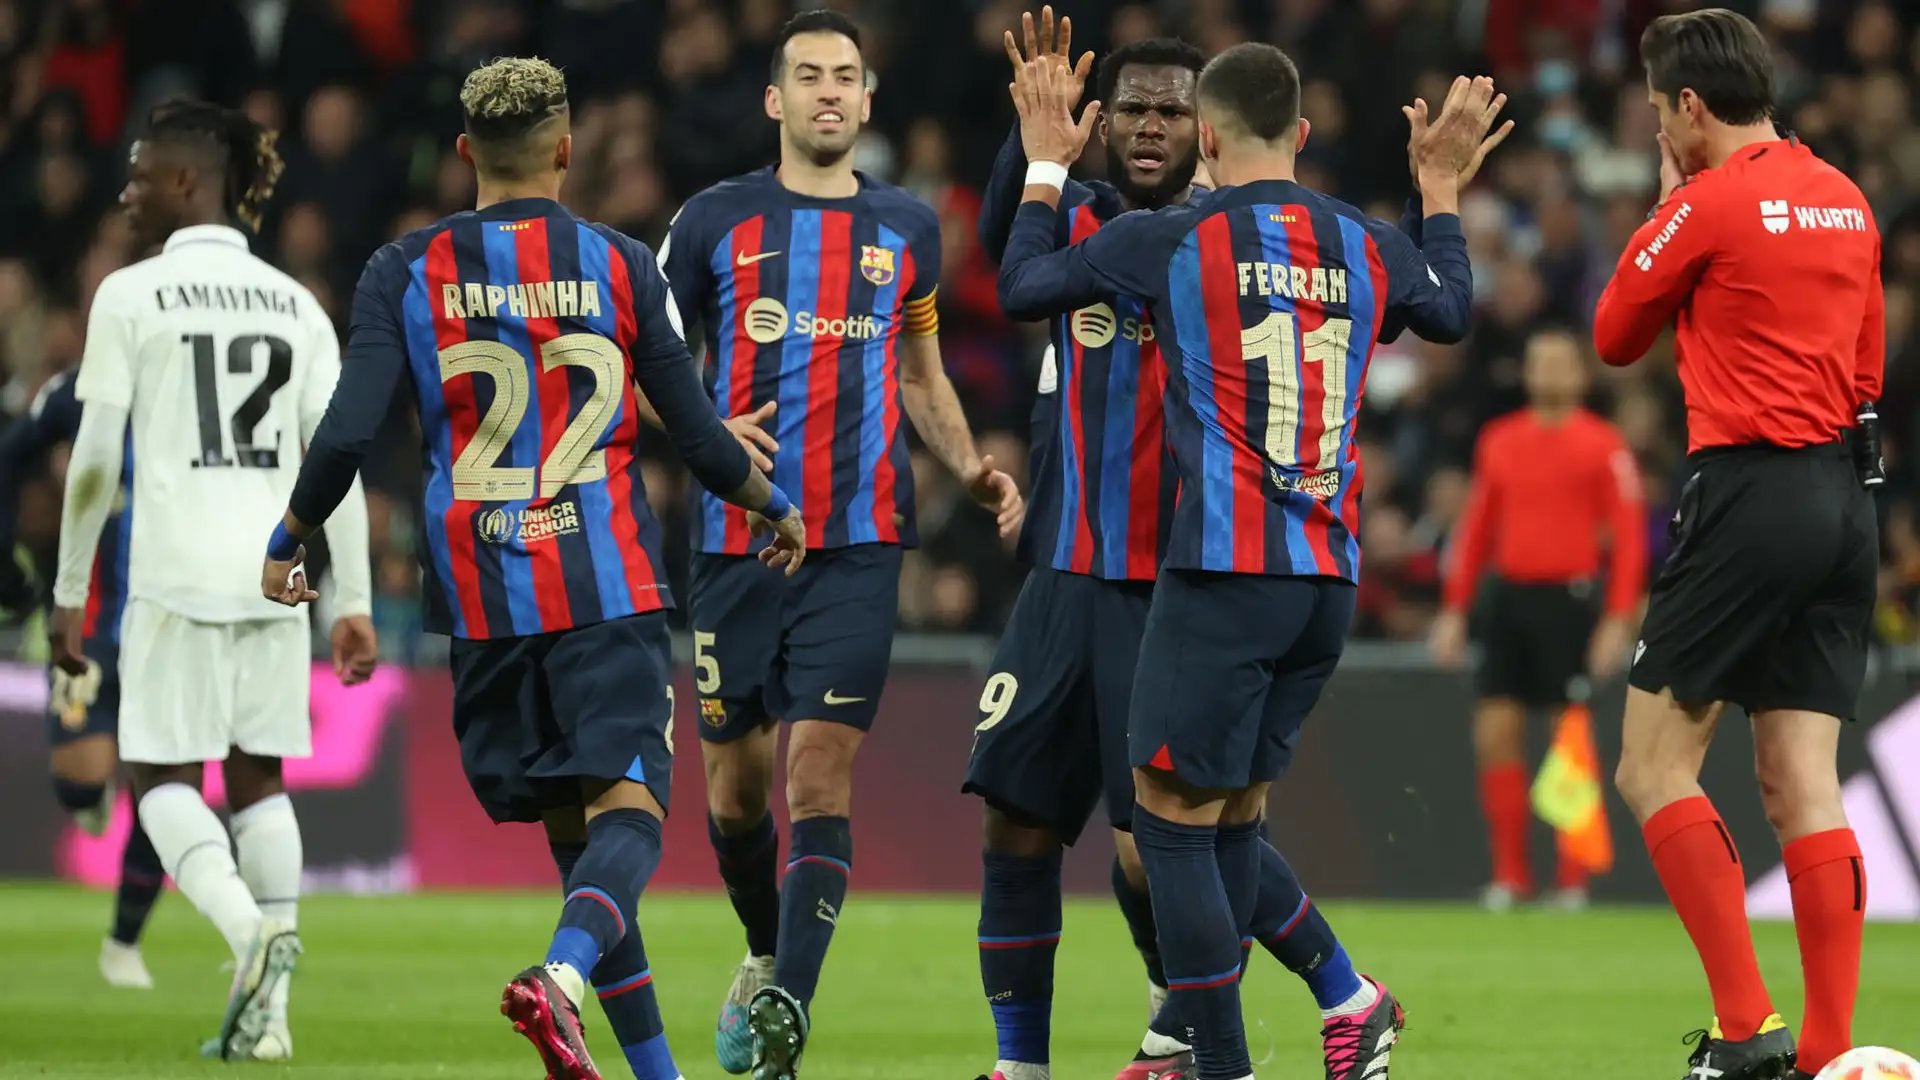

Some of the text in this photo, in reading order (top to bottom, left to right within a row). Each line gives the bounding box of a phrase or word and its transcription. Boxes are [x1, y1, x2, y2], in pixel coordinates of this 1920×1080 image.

[442, 281, 601, 319] RAPHINHA
[1237, 262, 1347, 303] FERRAN
[794, 311, 884, 338] Spotify
[181, 334, 292, 468] 12
[1240, 312, 1352, 469] 11
[437, 333, 624, 501] 22
[516, 515, 578, 537] ACNUR
[518, 501, 576, 523] UNHCR
[694, 630, 721, 694] 5
[975, 671, 1019, 732] 9
